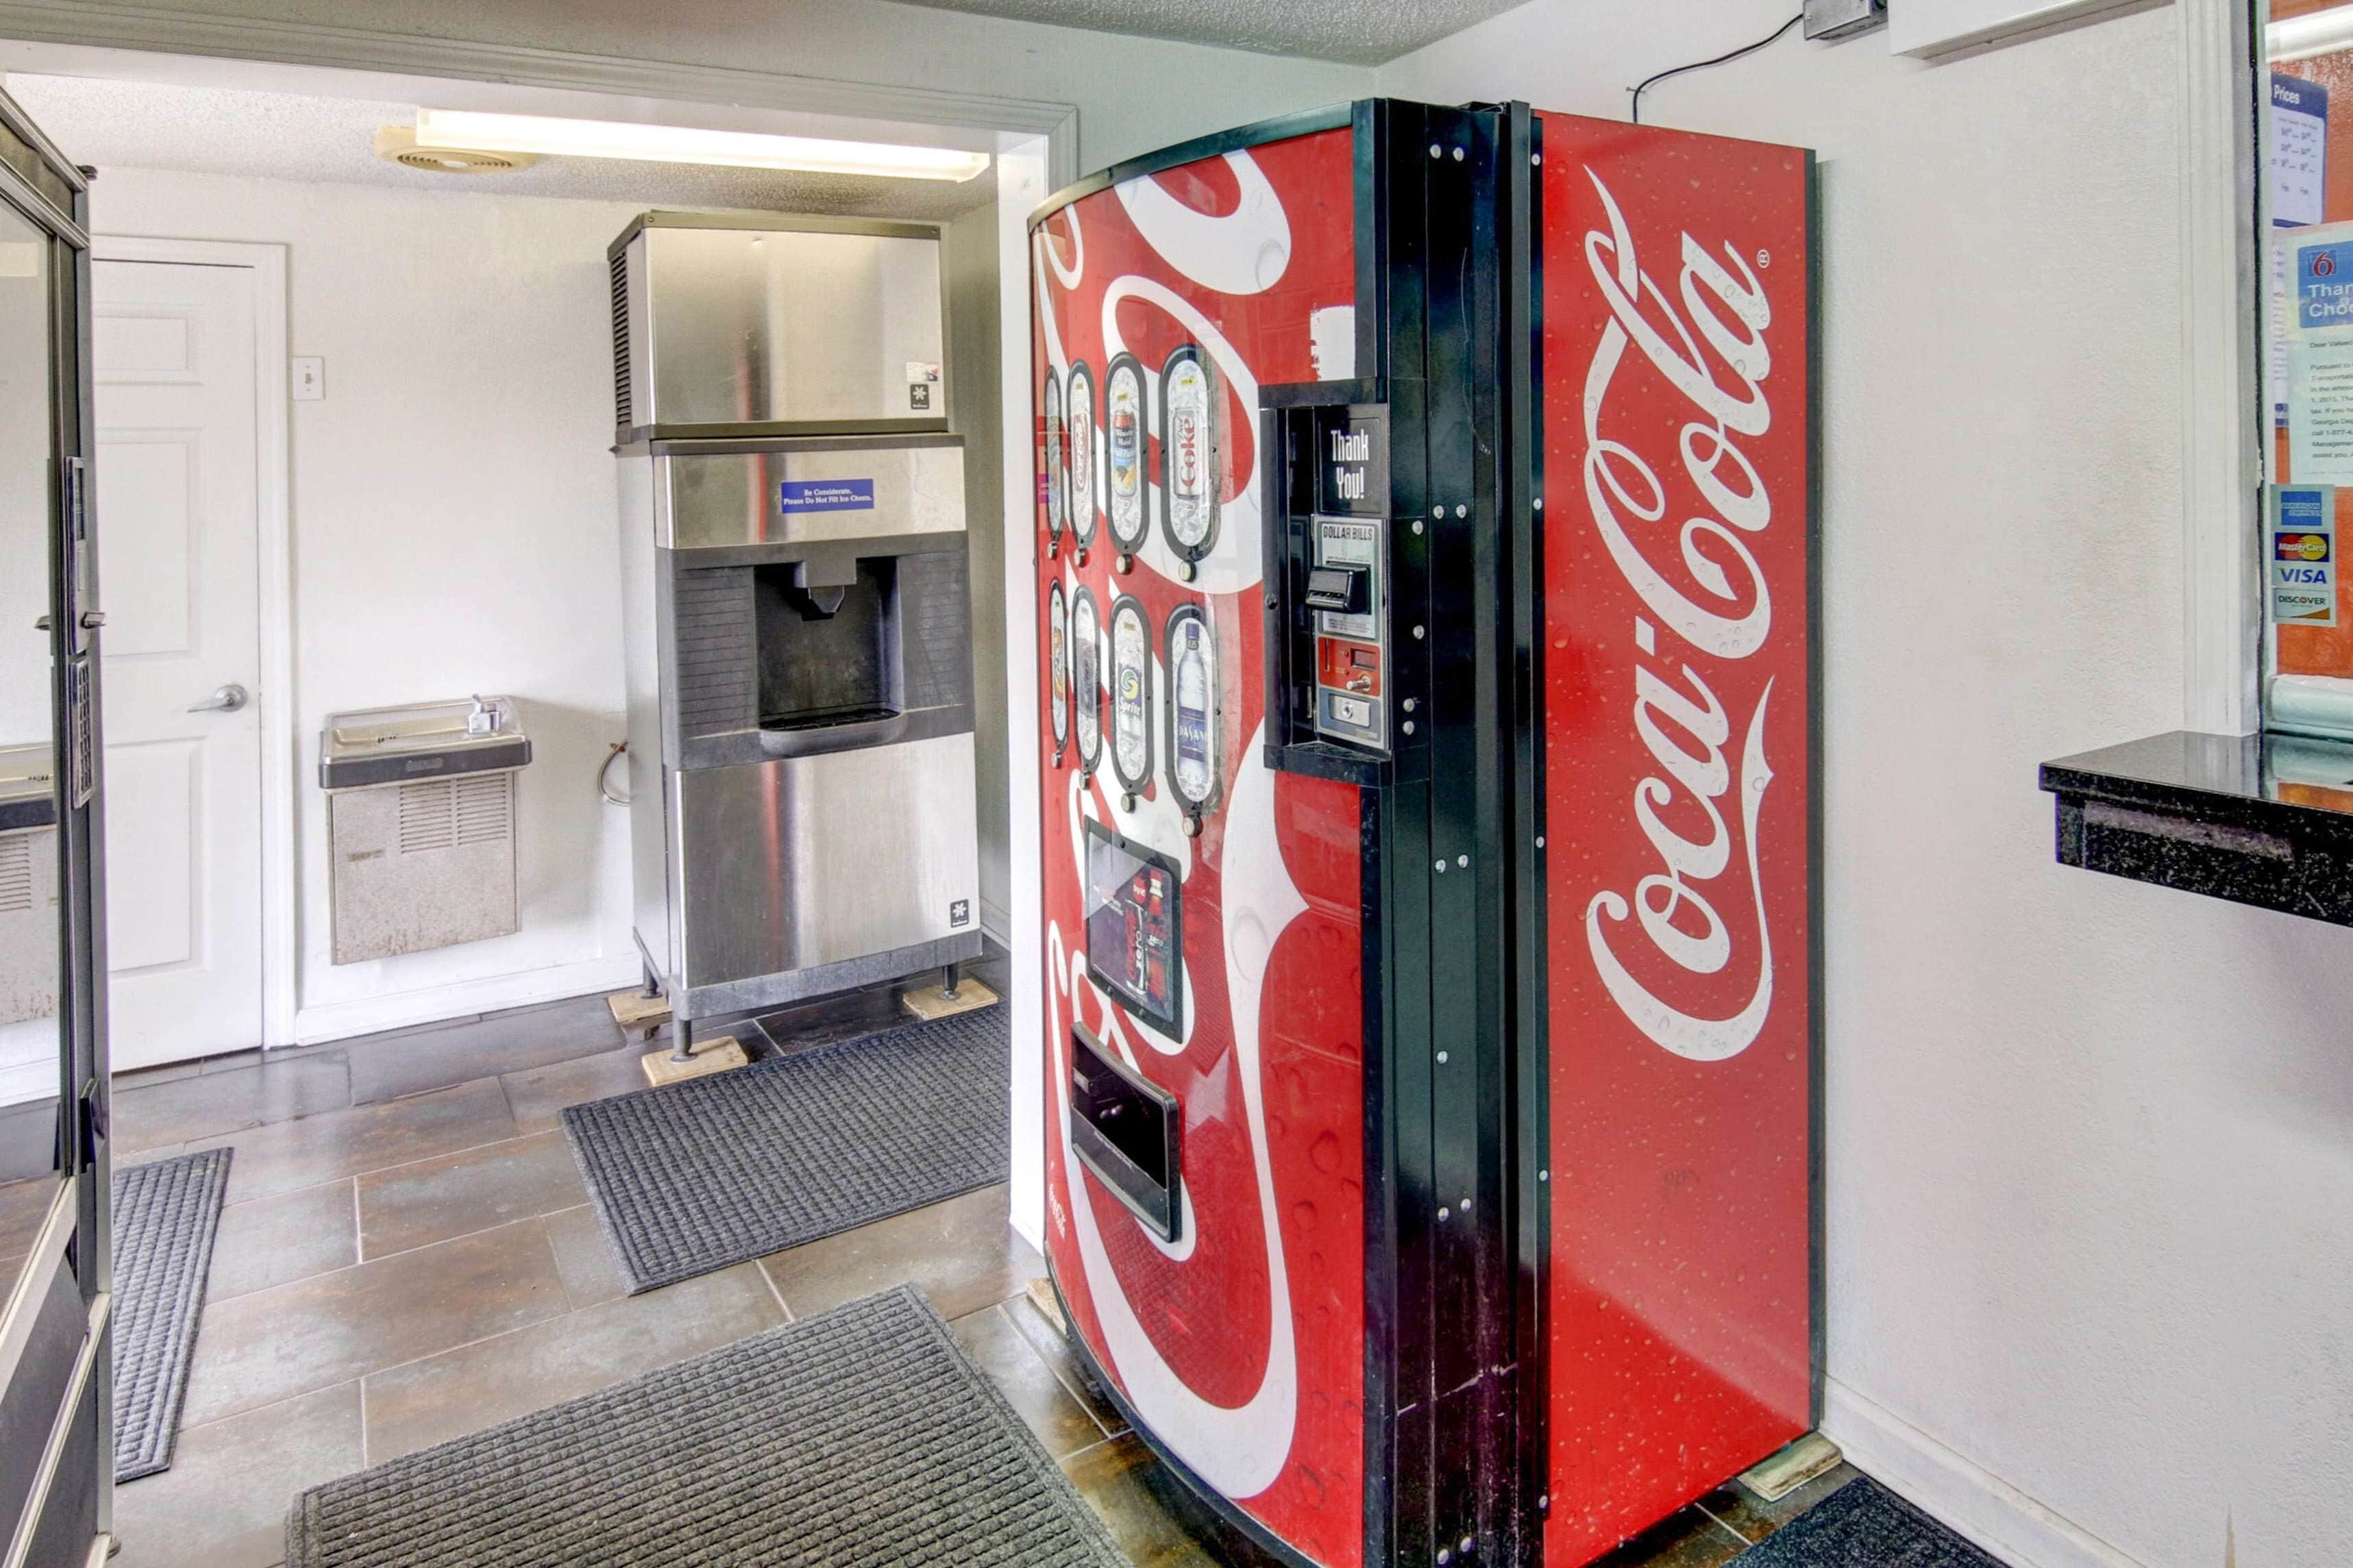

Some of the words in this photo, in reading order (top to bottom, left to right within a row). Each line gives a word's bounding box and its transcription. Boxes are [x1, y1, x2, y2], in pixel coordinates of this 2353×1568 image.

[2274, 84, 2300, 104] Prices
[2313, 251, 2334, 277] 6
[1180, 419, 1195, 487] Coke
[1331, 429, 1368, 462] Thank
[1336, 466, 1364, 499] You!
[1323, 526, 1351, 539] DOLLAR
[1353, 527, 1372, 541] BILLS
[2278, 543, 2325, 551] MasterCard
[2280, 568, 2328, 584] VISA
[2278, 595, 2326, 605] DISCOVER
[1119, 696, 1141, 715] Sprite
